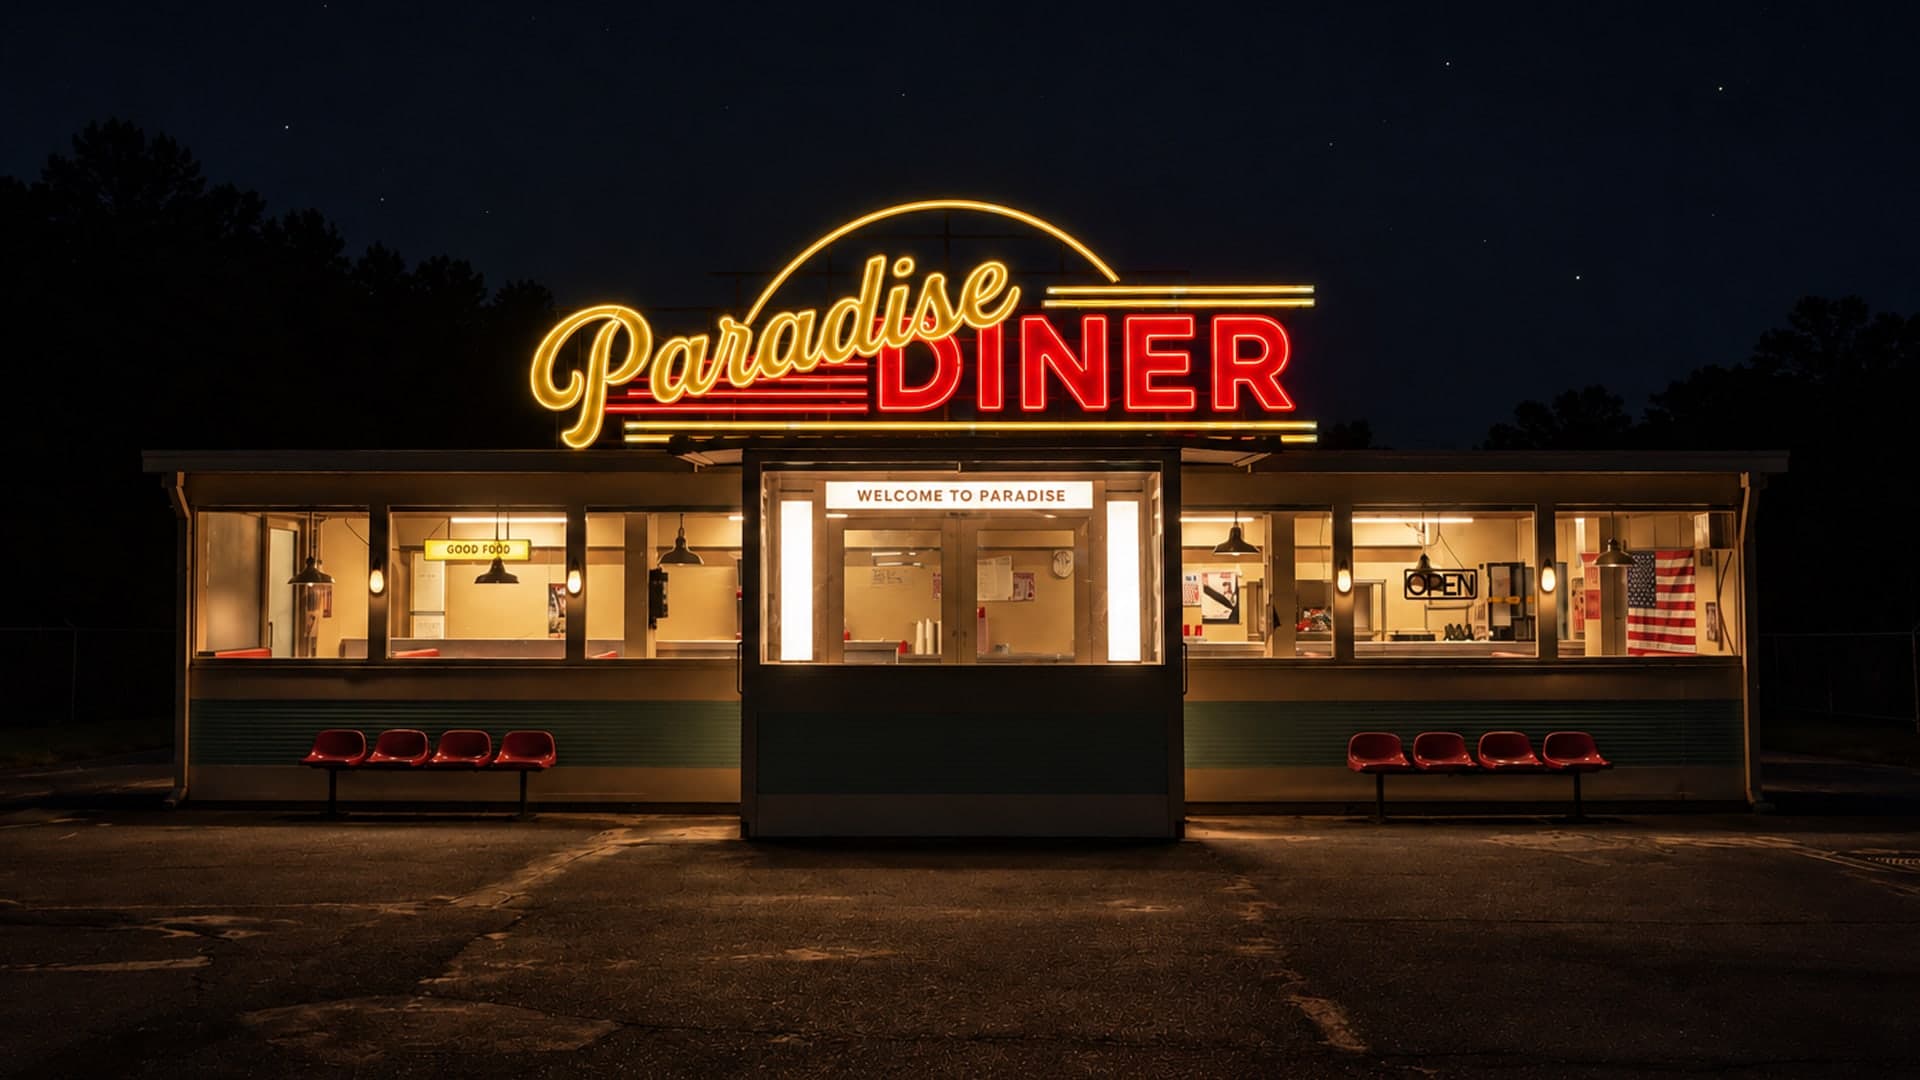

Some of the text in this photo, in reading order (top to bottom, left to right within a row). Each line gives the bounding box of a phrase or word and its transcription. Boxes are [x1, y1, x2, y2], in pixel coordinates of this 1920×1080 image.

[530, 254, 1021, 449] Paradise
[877, 314, 1296, 412] DINER
[857, 489, 1066, 502] WELCOME TO PARADISE
[447, 544, 511, 554] GOOD FOOD
[1407, 572, 1474, 596] OPEN
